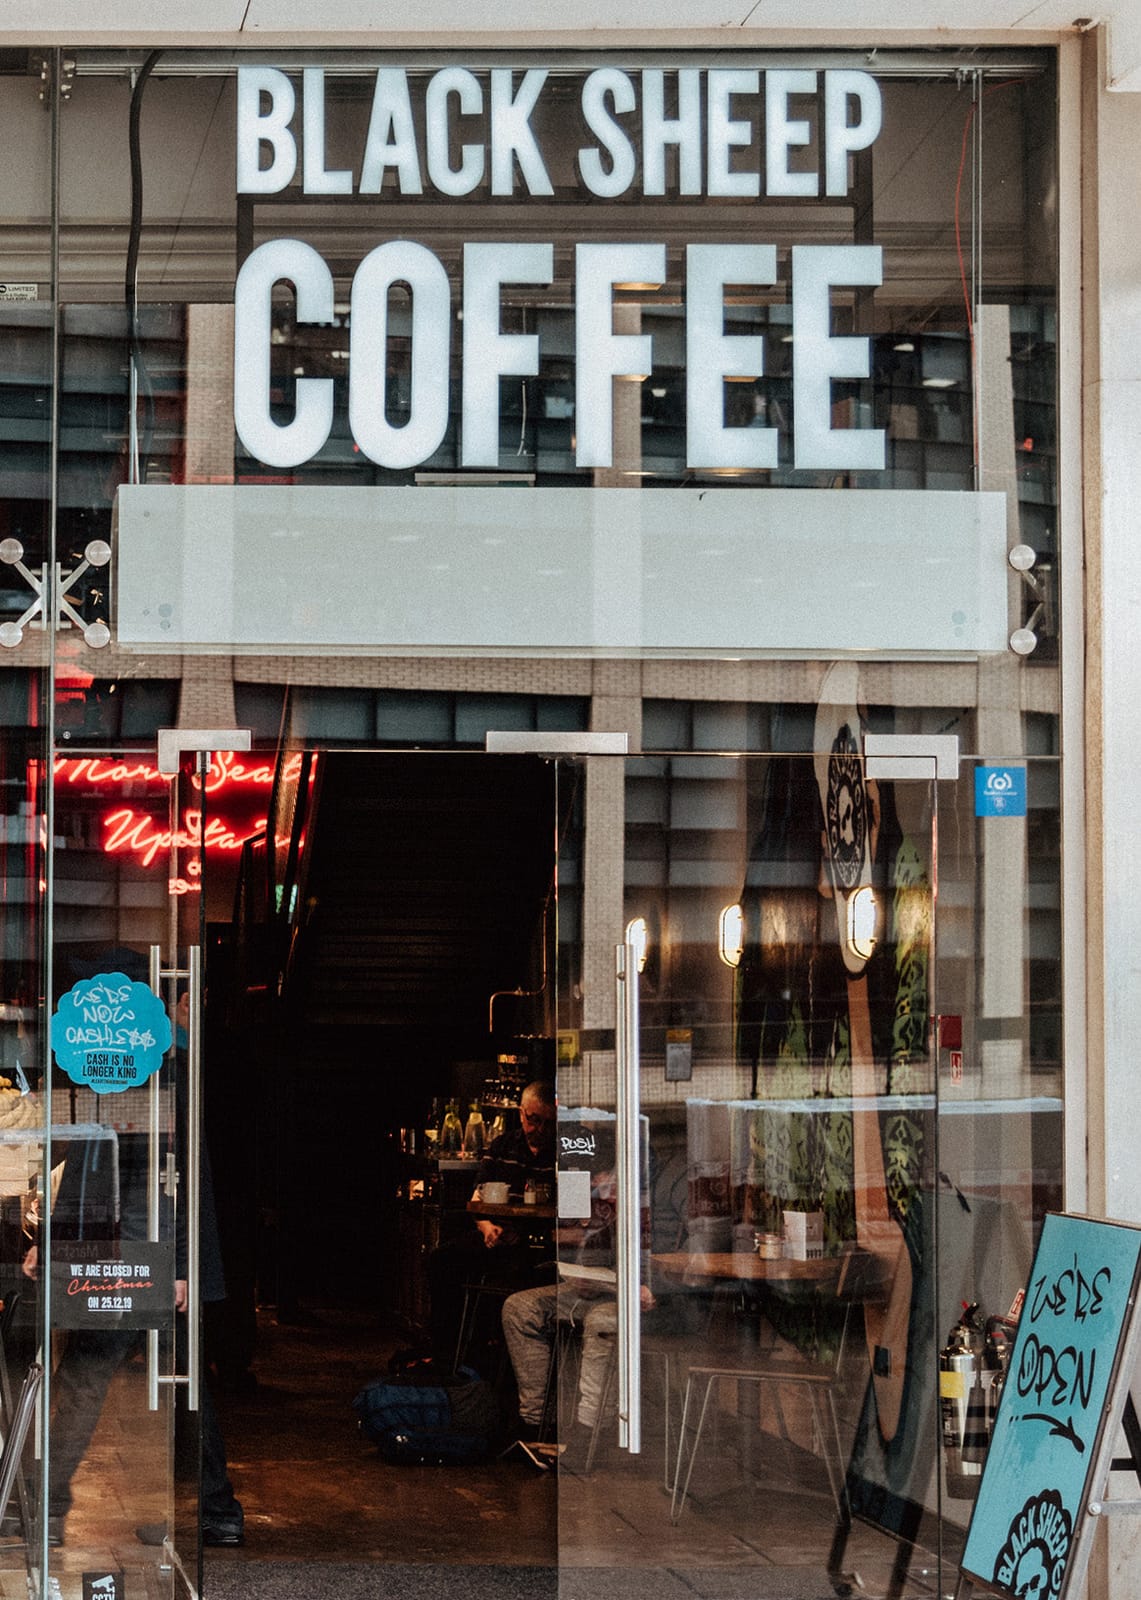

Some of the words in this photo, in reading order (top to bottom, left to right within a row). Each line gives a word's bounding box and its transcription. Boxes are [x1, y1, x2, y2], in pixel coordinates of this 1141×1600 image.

[236, 66, 555, 197] BLACK
[577, 66, 884, 198] SHEEP
[233, 237, 887, 471] COFFEE
[83, 1005, 136, 1024] NOW
[86, 1054, 109, 1066] CASH
[111, 1054, 120, 1066] IS
[122, 1055, 135, 1067] NO
[82, 1065, 115, 1078] LONGER
[117, 1067, 137, 1079] KING
[560, 1135, 596, 1151] PUSH
[70, 1264, 83, 1276] WE
[85, 1265, 101, 1277] ARE
[103, 1265, 132, 1277] CLOSED
[134, 1265, 150, 1277] FOR
[67, 1277, 154, 1296] Christmas
[88, 1296, 99, 1309] ON
[101, 1297, 132, 1309] 25.12.19
[1017, 1333, 1097, 1410] OPEN
[997, 1504, 1037, 1587] BLACK
[1036, 1501, 1069, 1560] SHEEP
